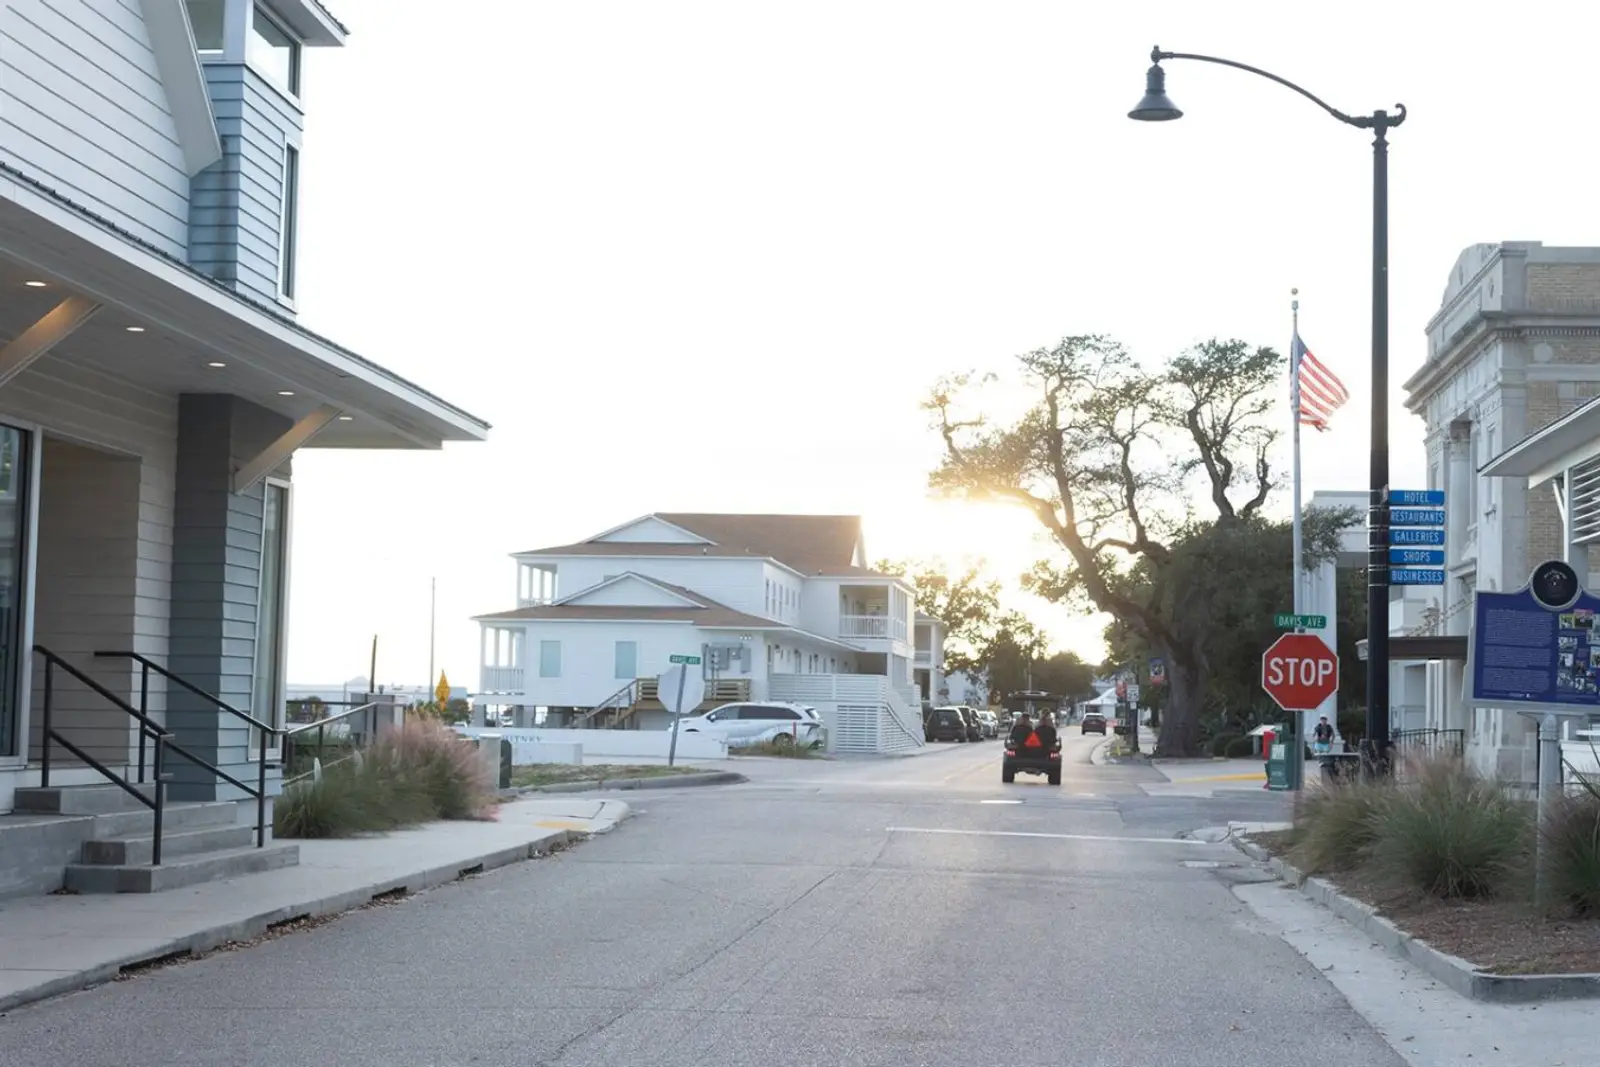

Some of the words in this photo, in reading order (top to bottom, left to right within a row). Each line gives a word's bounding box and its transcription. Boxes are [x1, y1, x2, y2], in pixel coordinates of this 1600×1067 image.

[1404, 491, 1429, 502] HOTEL
[1391, 510, 1444, 523] RESTAURANTS
[1394, 531, 1440, 543] GALLERIES
[1403, 551, 1431, 562] SHOPS
[1391, 570, 1443, 582] BUSINESSES
[1279, 615, 1302, 627] DAVIS
[1307, 616, 1324, 627] AVE
[1268, 657, 1333, 687] STOP
